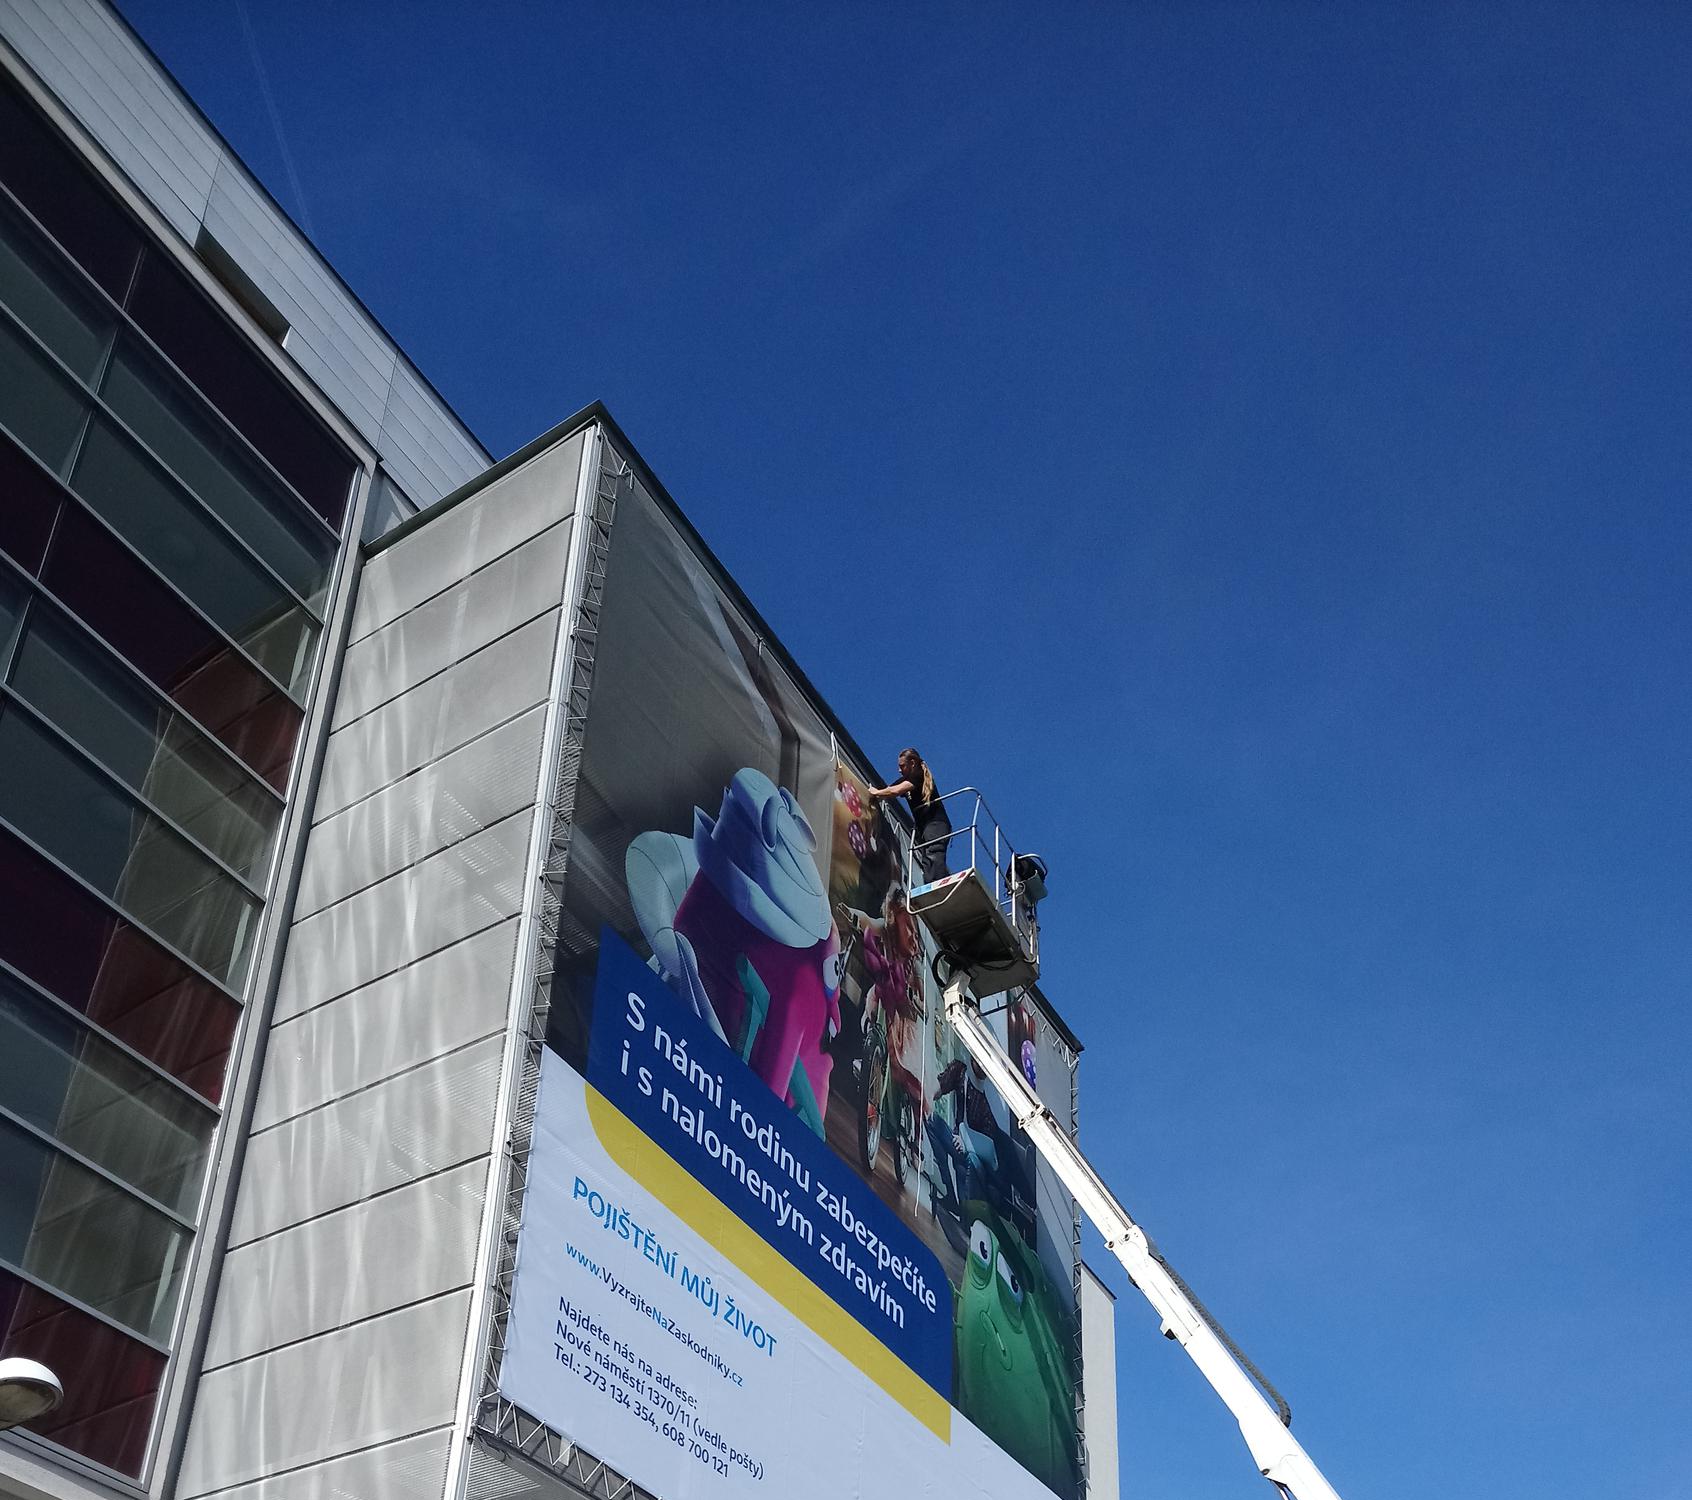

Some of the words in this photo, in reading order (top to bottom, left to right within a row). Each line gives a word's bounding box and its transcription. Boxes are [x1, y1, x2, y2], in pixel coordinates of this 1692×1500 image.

[621, 1039, 630, 1076] i
[638, 1067, 653, 1097] s
[662, 1091, 813, 1245] nalomeným
[820, 1237, 905, 1329] zdravím
[627, 992, 646, 1031] S
[654, 1024, 722, 1109] námi
[730, 1098, 810, 1191] rodinu
[816, 1181, 937, 1314] zabezpečíte
[565, 1242, 743, 1387] www.VyzrajteNaZaskodniky.cz
[573, 1176, 679, 1278] POJIŠTĚNÍ
[681, 1266, 719, 1316] MŮJ
[724, 1295, 777, 1357] ŽIVOT
[554, 1344, 581, 1375] Tel.:
[584, 1365, 607, 1393] 273
[610, 1383, 631, 1410] 134
[634, 1400, 659, 1433] 354,
[662, 1421, 685, 1448] 608
[689, 1440, 709, 1465] 700
[713, 1455, 729, 1478] 121
[556, 1319, 592, 1354] Nové
[594, 1345, 645, 1394] náměstí
[648, 1386, 690, 1428] 1370/11
[693, 1417, 727, 1455] (vedle
[730, 1446, 765, 1481] pošty)
[559, 1297, 610, 1345] Najdete
[613, 1336, 636, 1365] nás
[638, 1356, 653, 1377] na
[656, 1369, 698, 1410] adrese:
